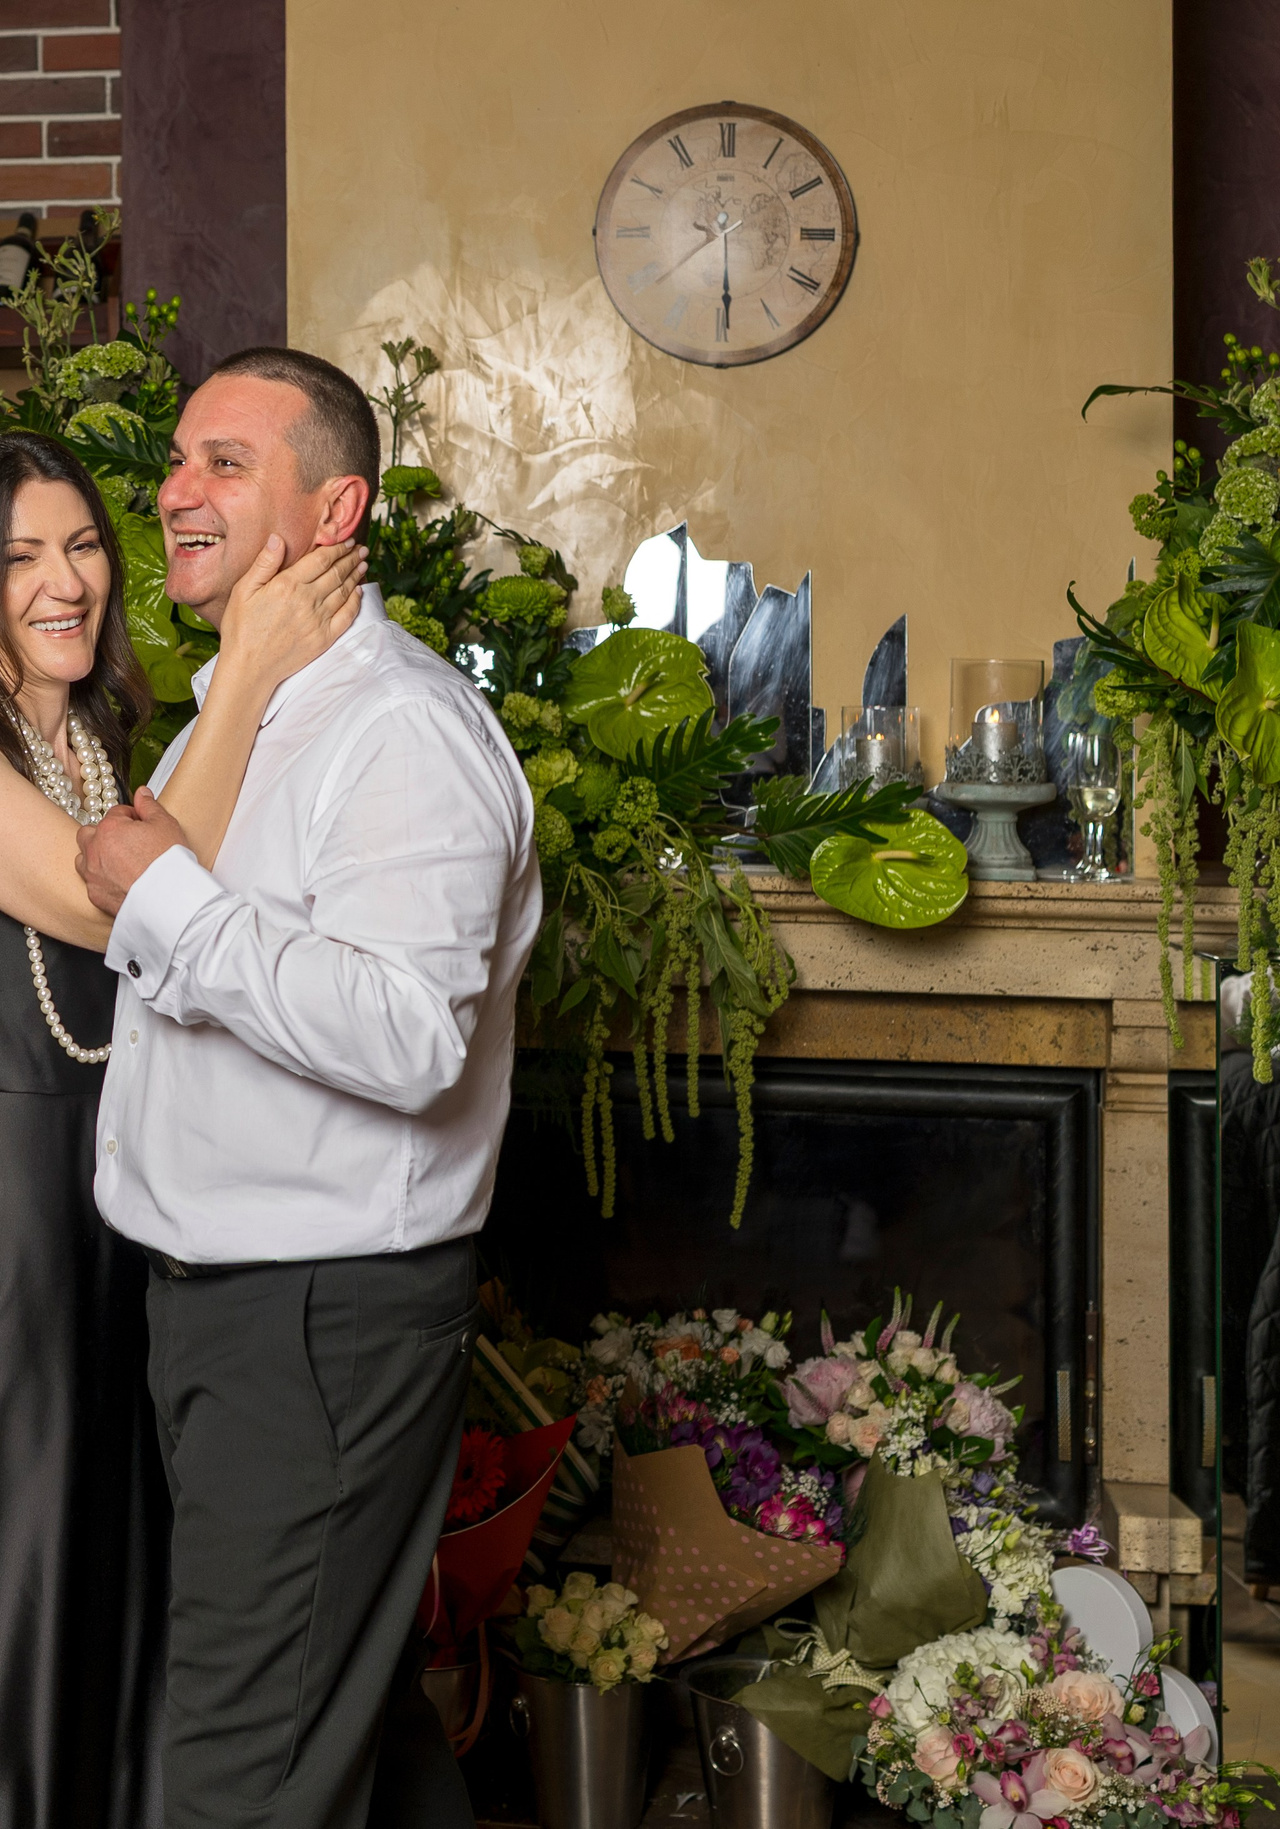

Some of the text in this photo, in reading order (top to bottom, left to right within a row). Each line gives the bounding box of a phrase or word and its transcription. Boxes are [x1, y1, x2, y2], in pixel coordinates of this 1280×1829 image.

[667, 134, 694, 171] XI
[719, 122, 737, 158] XII
[762, 137, 784, 169] I
[630, 174, 663, 198] X
[789, 176, 823, 200] II
[800, 227, 835, 241] III
